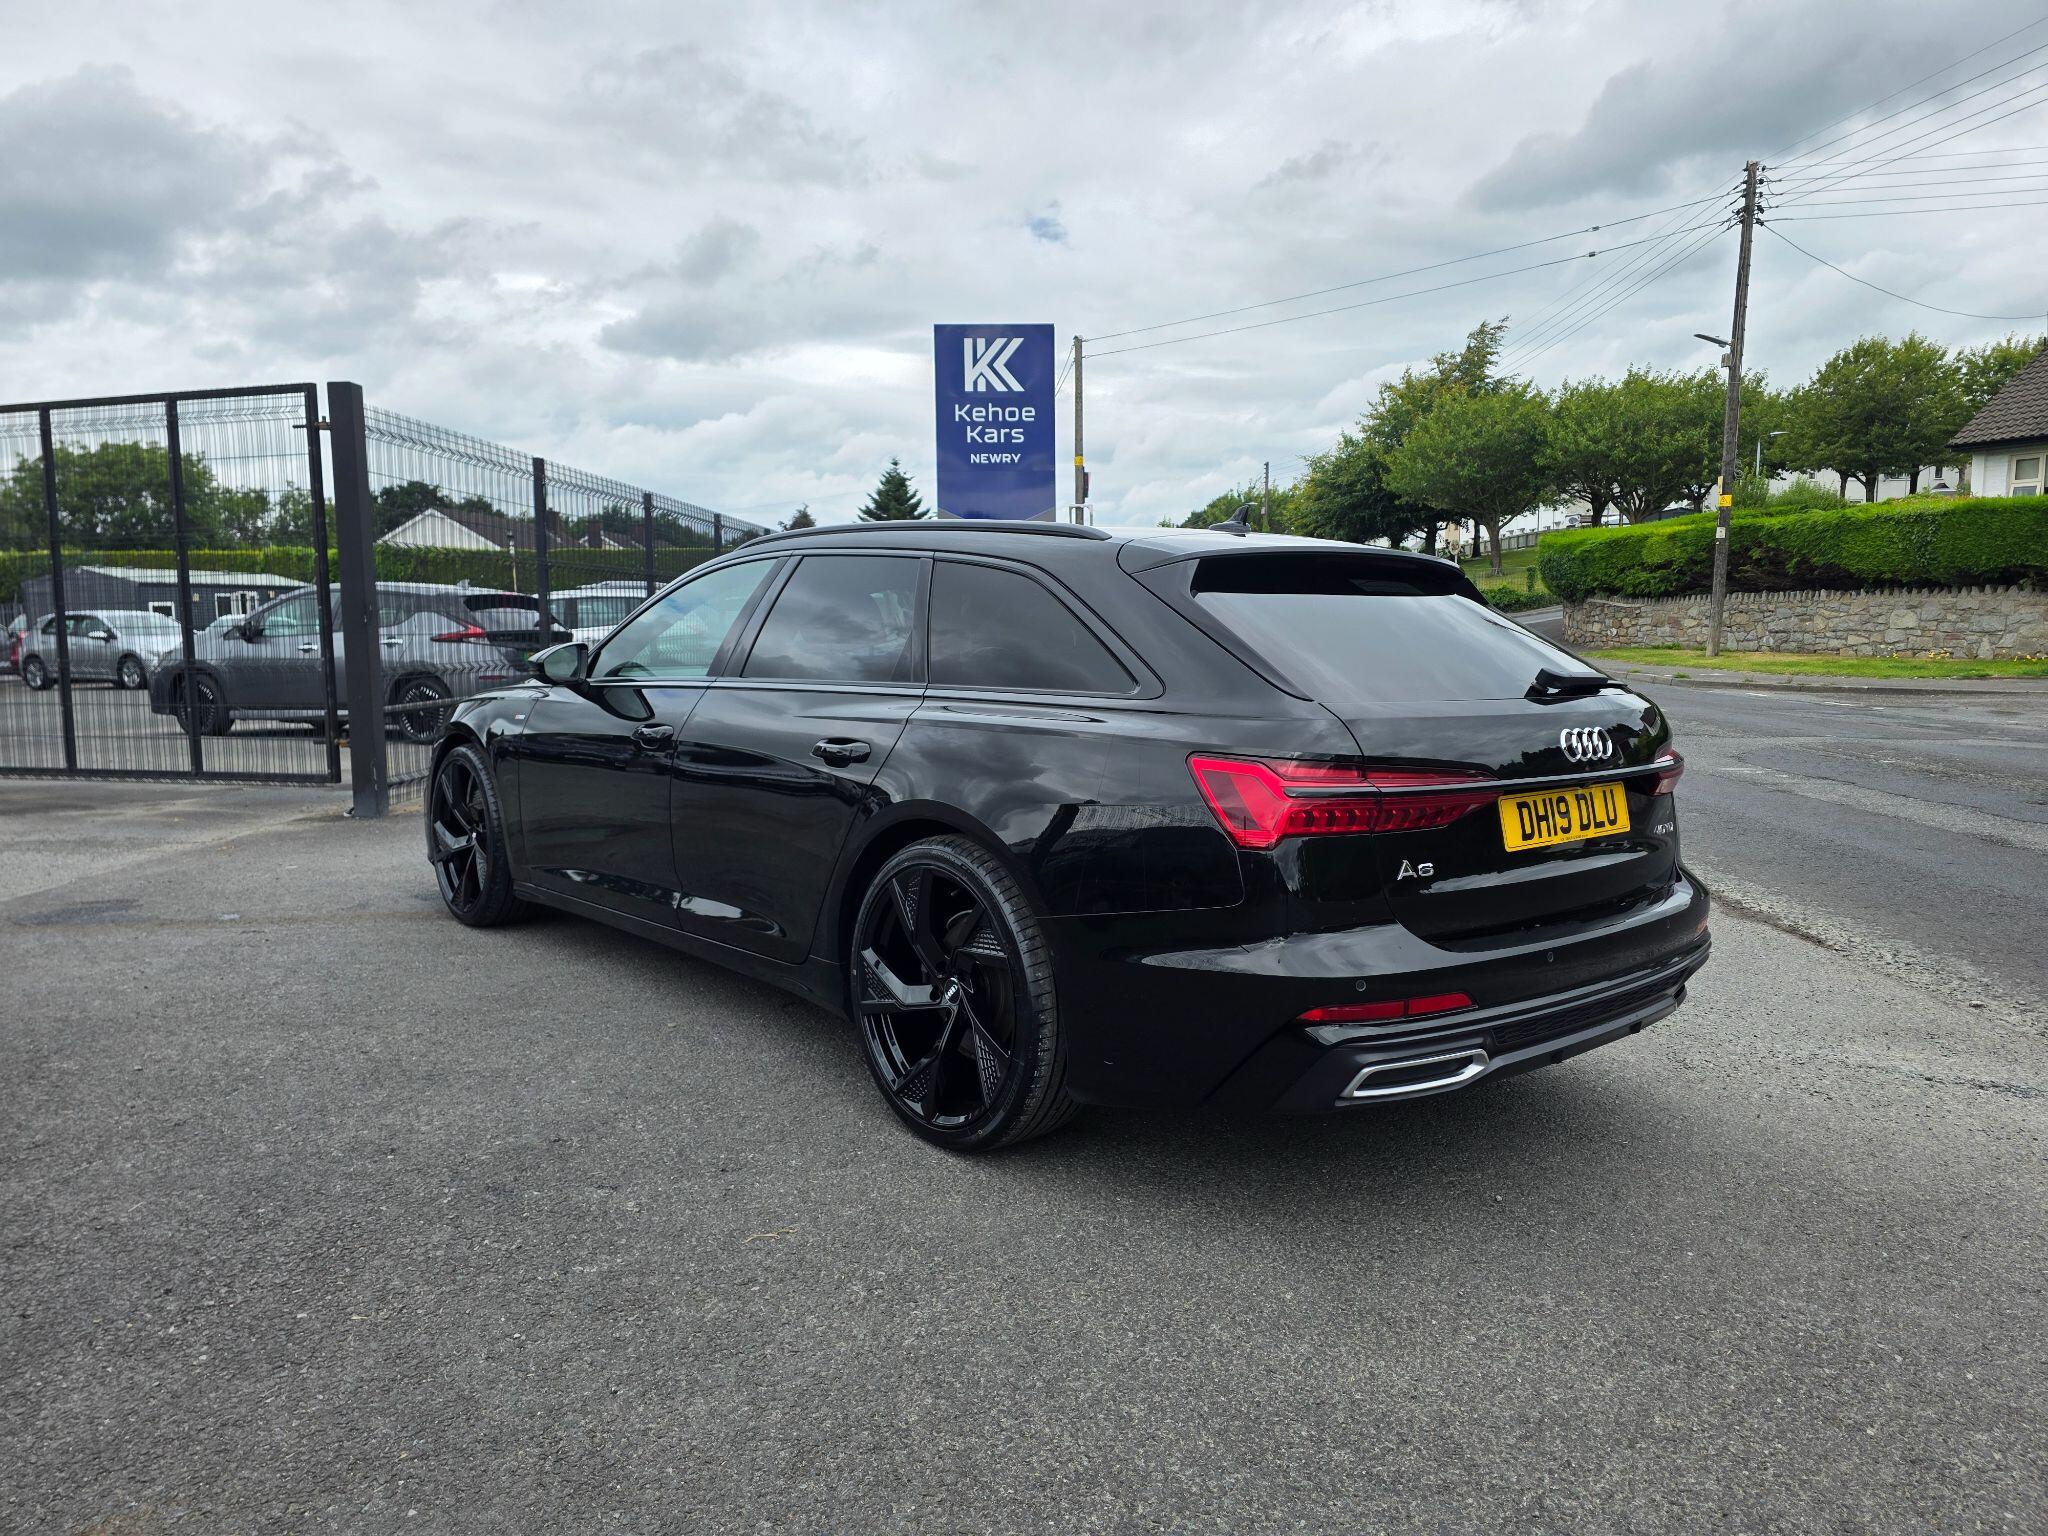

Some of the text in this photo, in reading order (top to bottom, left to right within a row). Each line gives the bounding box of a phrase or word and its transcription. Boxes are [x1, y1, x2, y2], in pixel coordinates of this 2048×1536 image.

[954, 403, 1036, 422] Kehoe
[966, 425, 1025, 443] Kars
[970, 453, 1021, 464] NEWRY
[1516, 788, 1618, 842] DH19 DLU
[1397, 859, 1434, 881] A6
